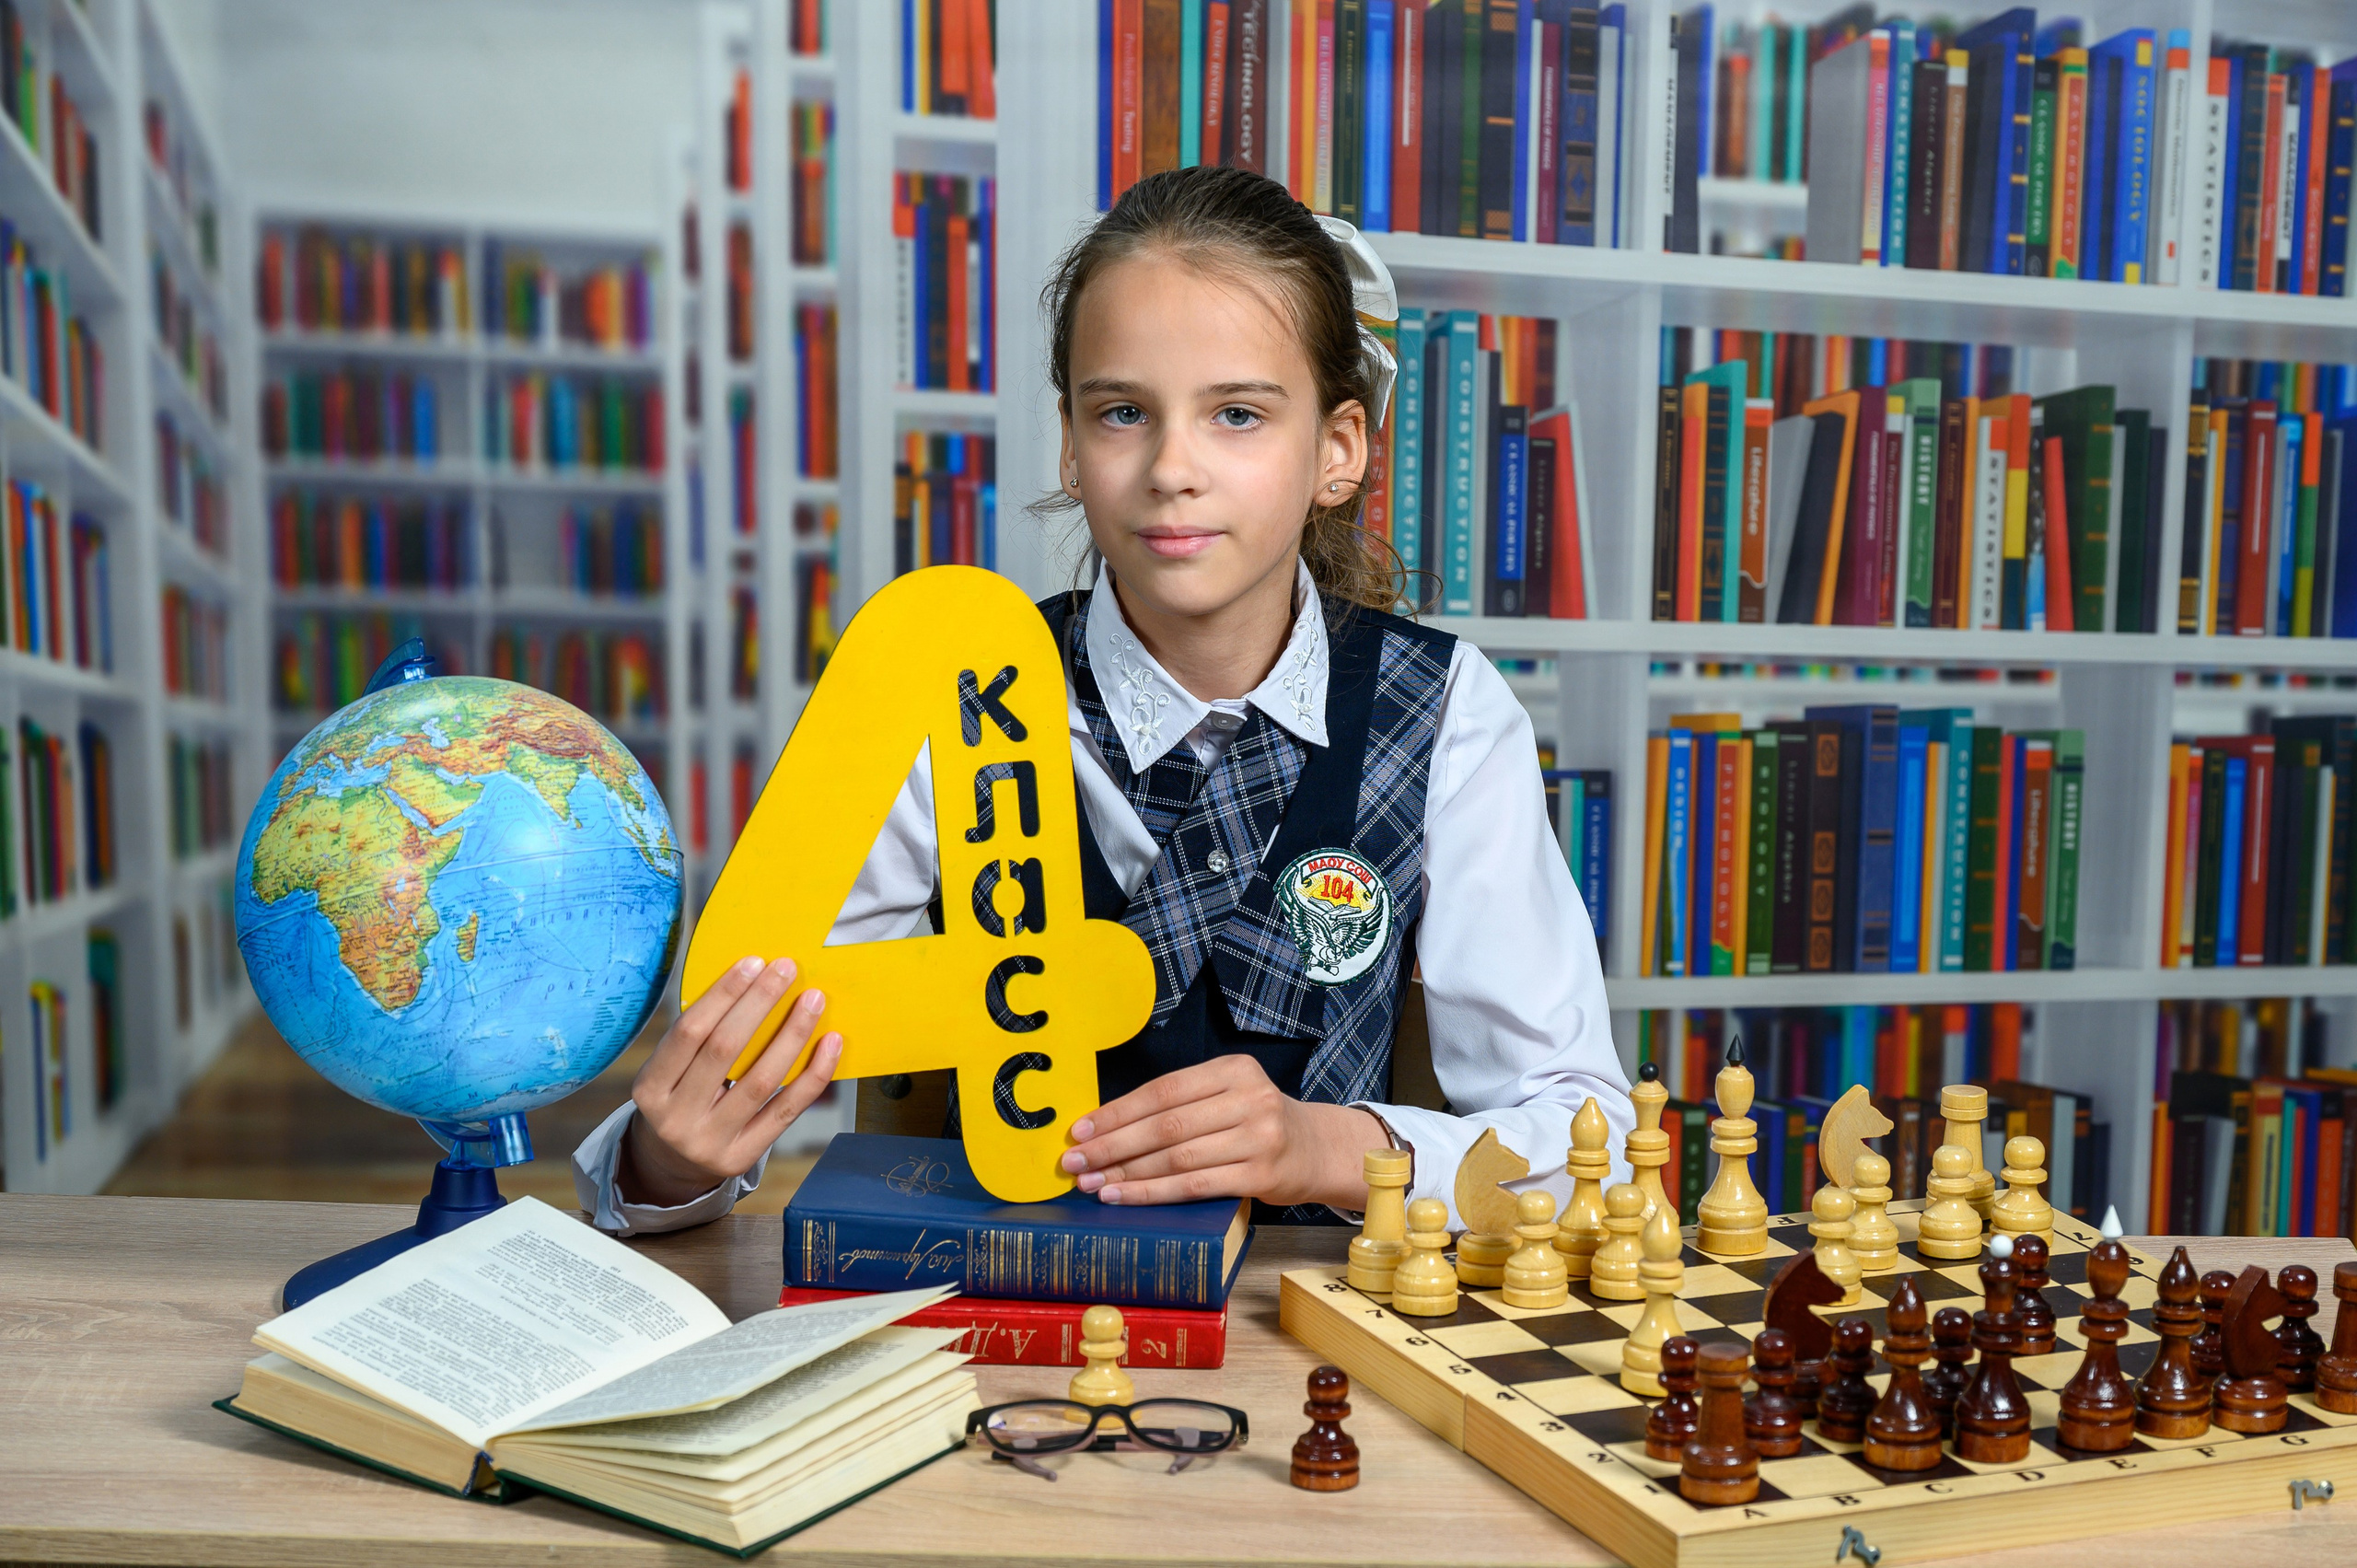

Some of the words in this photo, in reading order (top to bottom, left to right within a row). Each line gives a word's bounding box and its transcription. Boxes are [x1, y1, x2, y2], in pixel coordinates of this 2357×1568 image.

[1240, 10, 1255, 163] TECHNOLOGY
[1121, 111, 1135, 153] Testing
[1893, 63, 1909, 248] CONSTRUCTION
[1455, 361, 1470, 582] CONSTRUCTION
[1747, 447, 1762, 536] Literature
[1917, 436, 1933, 506] HISTORY
[1983, 456, 1999, 621] STATISTICS
[1755, 766, 1770, 896] BIOLOGY
[1951, 749, 1968, 941] CONSTRUCTION
[2026, 789, 2042, 878] Literature
[2062, 783, 2078, 851] HISTORY
[1307, 857, 1345, 873] МАОУ
[1346, 862, 1373, 884] СОШ
[1321, 875, 1354, 902] 104
[1142, 1338, 1167, 1360] 2
[1742, 1508, 1768, 1519] A
[1833, 1495, 1861, 1505] B
[1925, 1482, 1953, 1493] C
[2015, 1471, 2044, 1481] D
[2112, 1458, 2136, 1469] E
[2199, 1446, 2218, 1458] F
[2282, 1434, 2309, 1446] G
